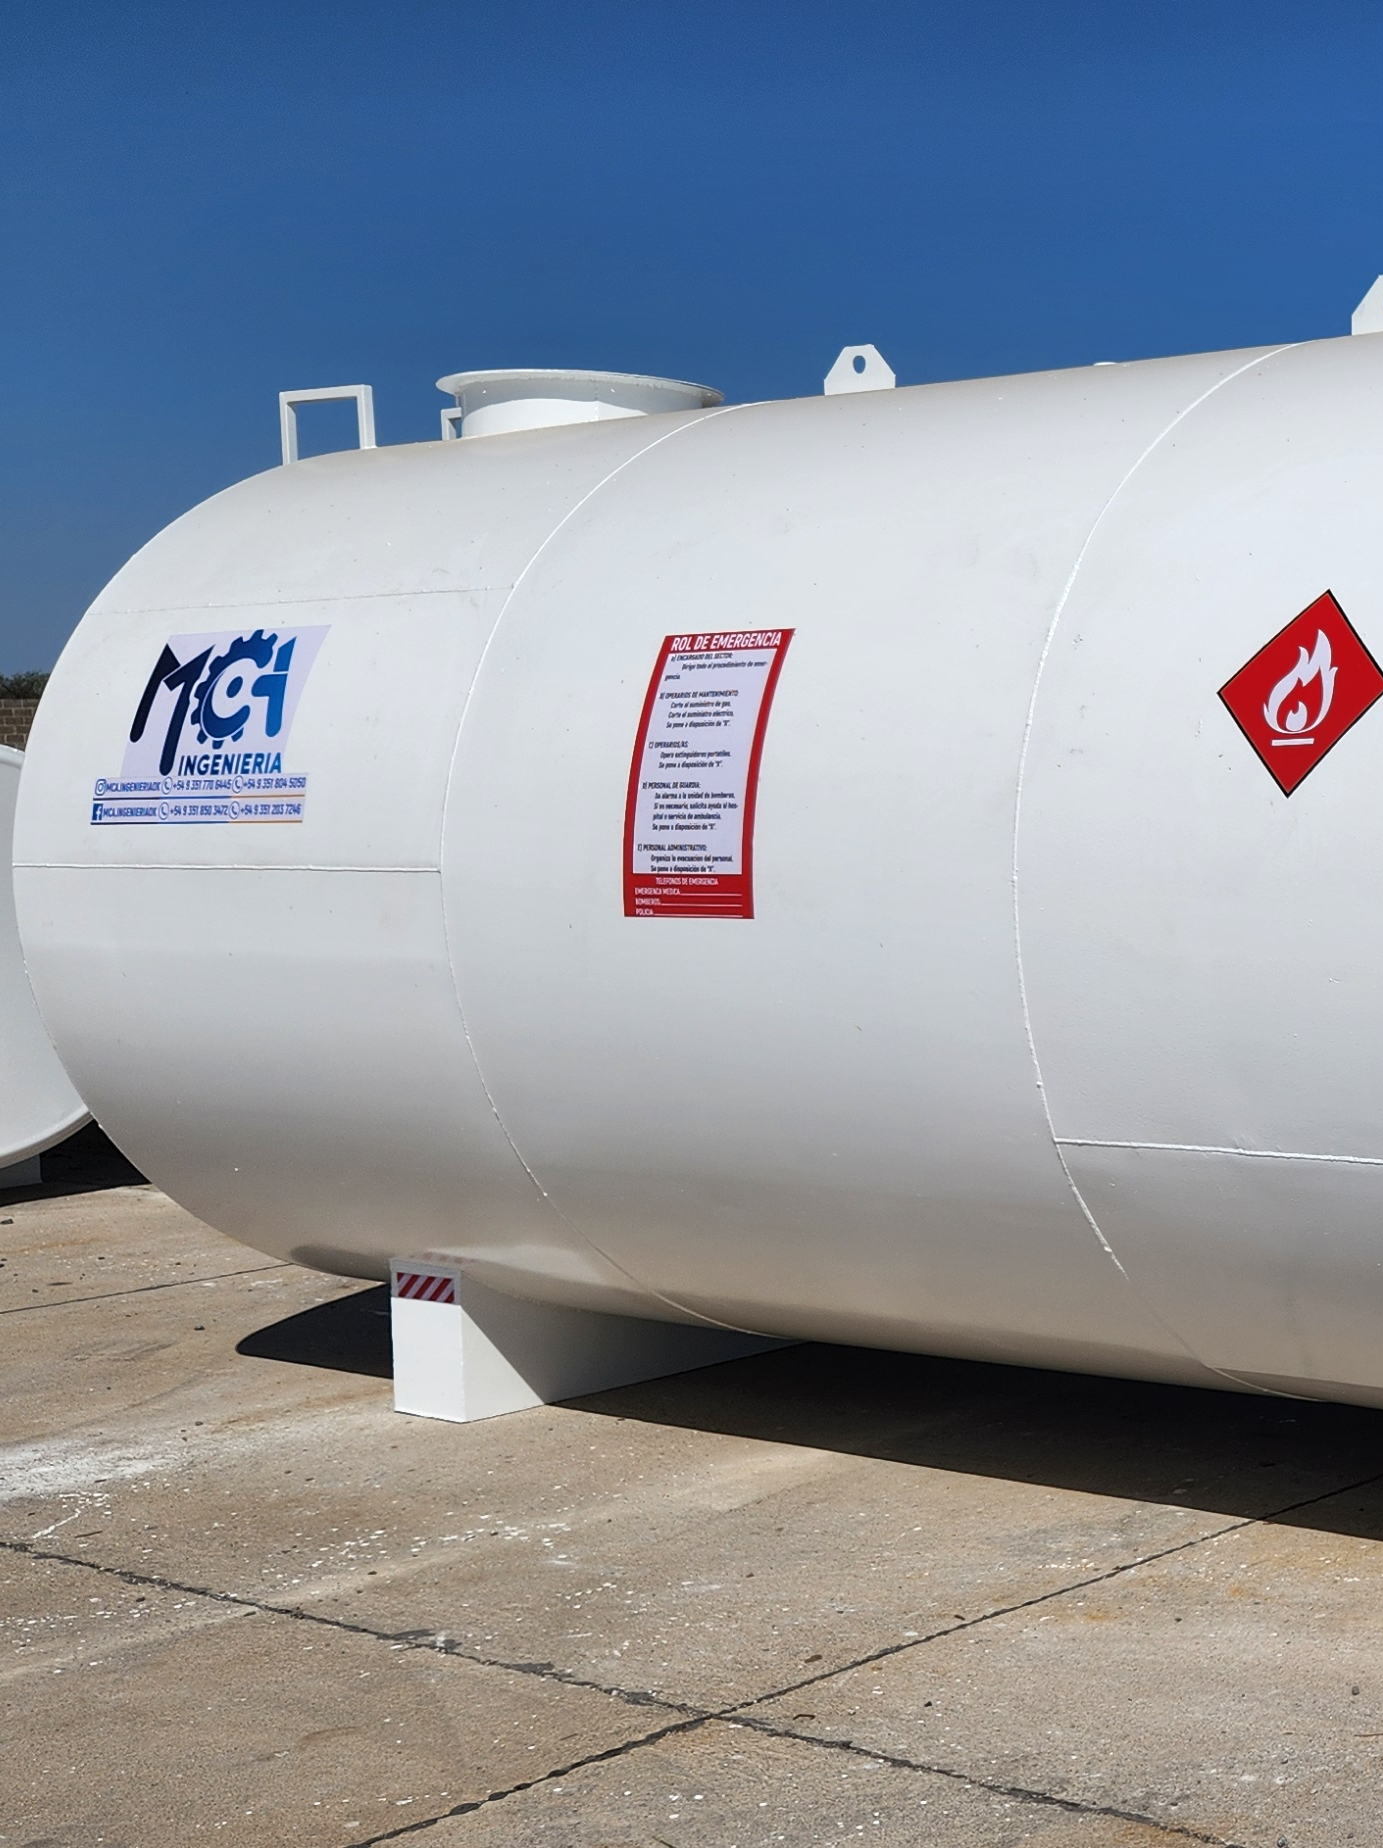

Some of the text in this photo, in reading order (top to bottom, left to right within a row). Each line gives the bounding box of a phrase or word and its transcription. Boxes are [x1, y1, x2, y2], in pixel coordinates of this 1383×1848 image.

[671, 632, 782, 651] ROL DE EMERGENCIA
[178, 752, 282, 776] INGENIERIA
[186, 780, 190, 790] 9
[191, 780, 201, 790] 351
[257, 779, 261, 789] 9
[262, 778, 273, 789] 351
[183, 805, 187, 815] 9
[188, 805, 199, 815] 351
[254, 804, 258, 815] 9
[259, 804, 270, 815] 351
